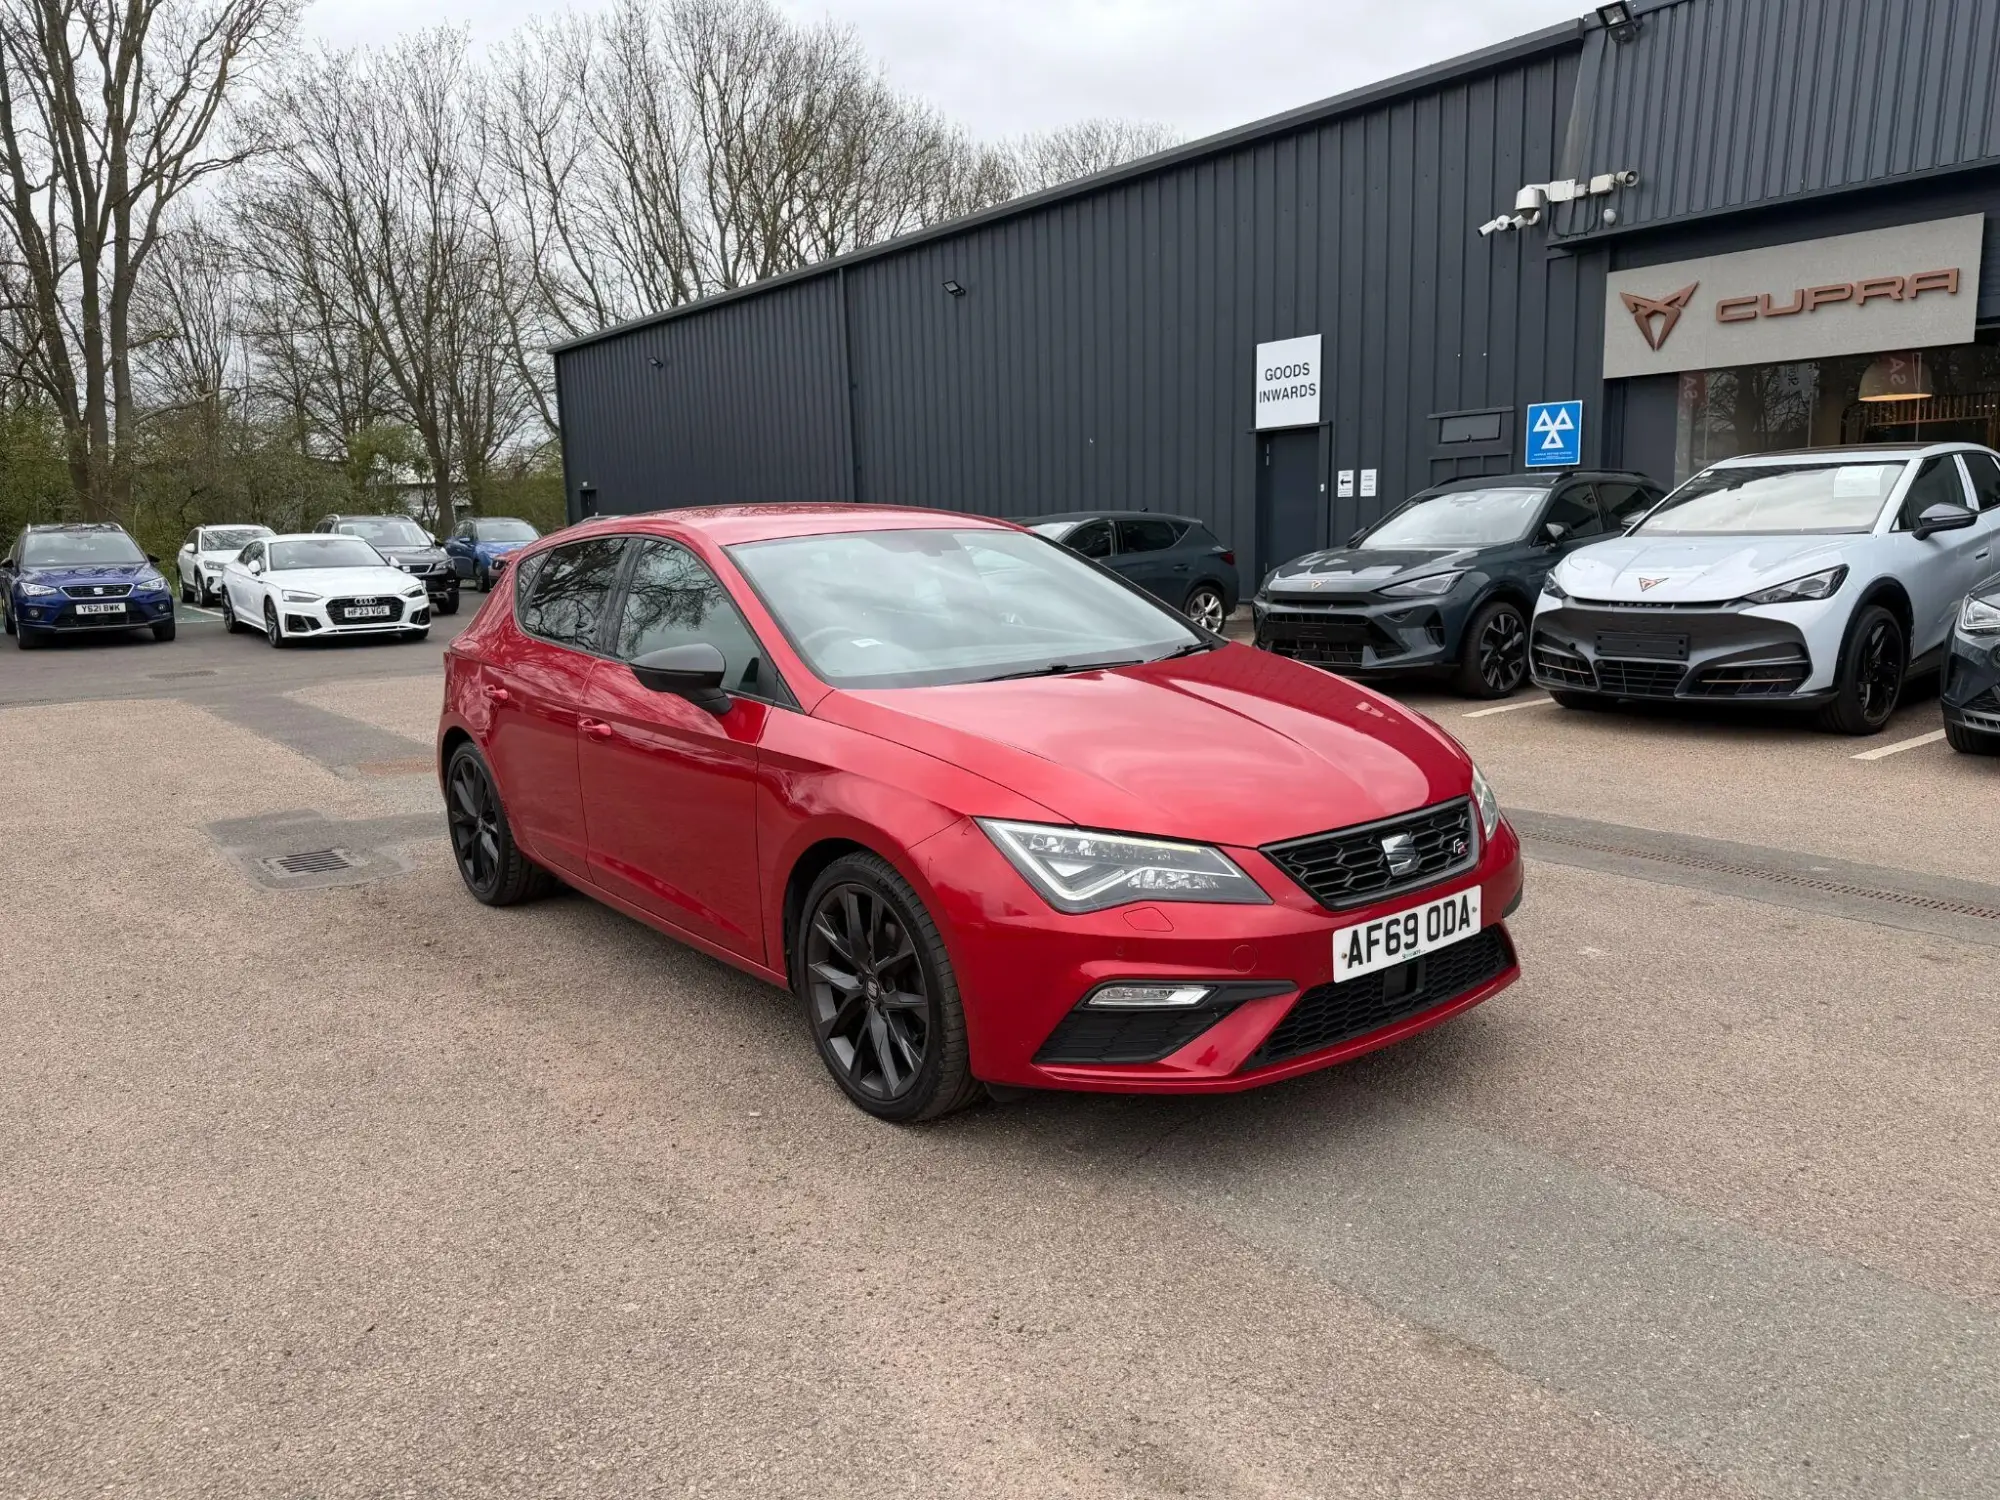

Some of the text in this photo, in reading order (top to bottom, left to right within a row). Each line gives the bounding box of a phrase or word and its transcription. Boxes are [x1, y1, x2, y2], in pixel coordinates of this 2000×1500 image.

[1716, 268, 1960, 322] CUPRA
[1265, 362, 1310, 381] GOODS
[1259, 383, 1316, 403] INWARDS
[1347, 895, 1471, 969] AF69 ODA
